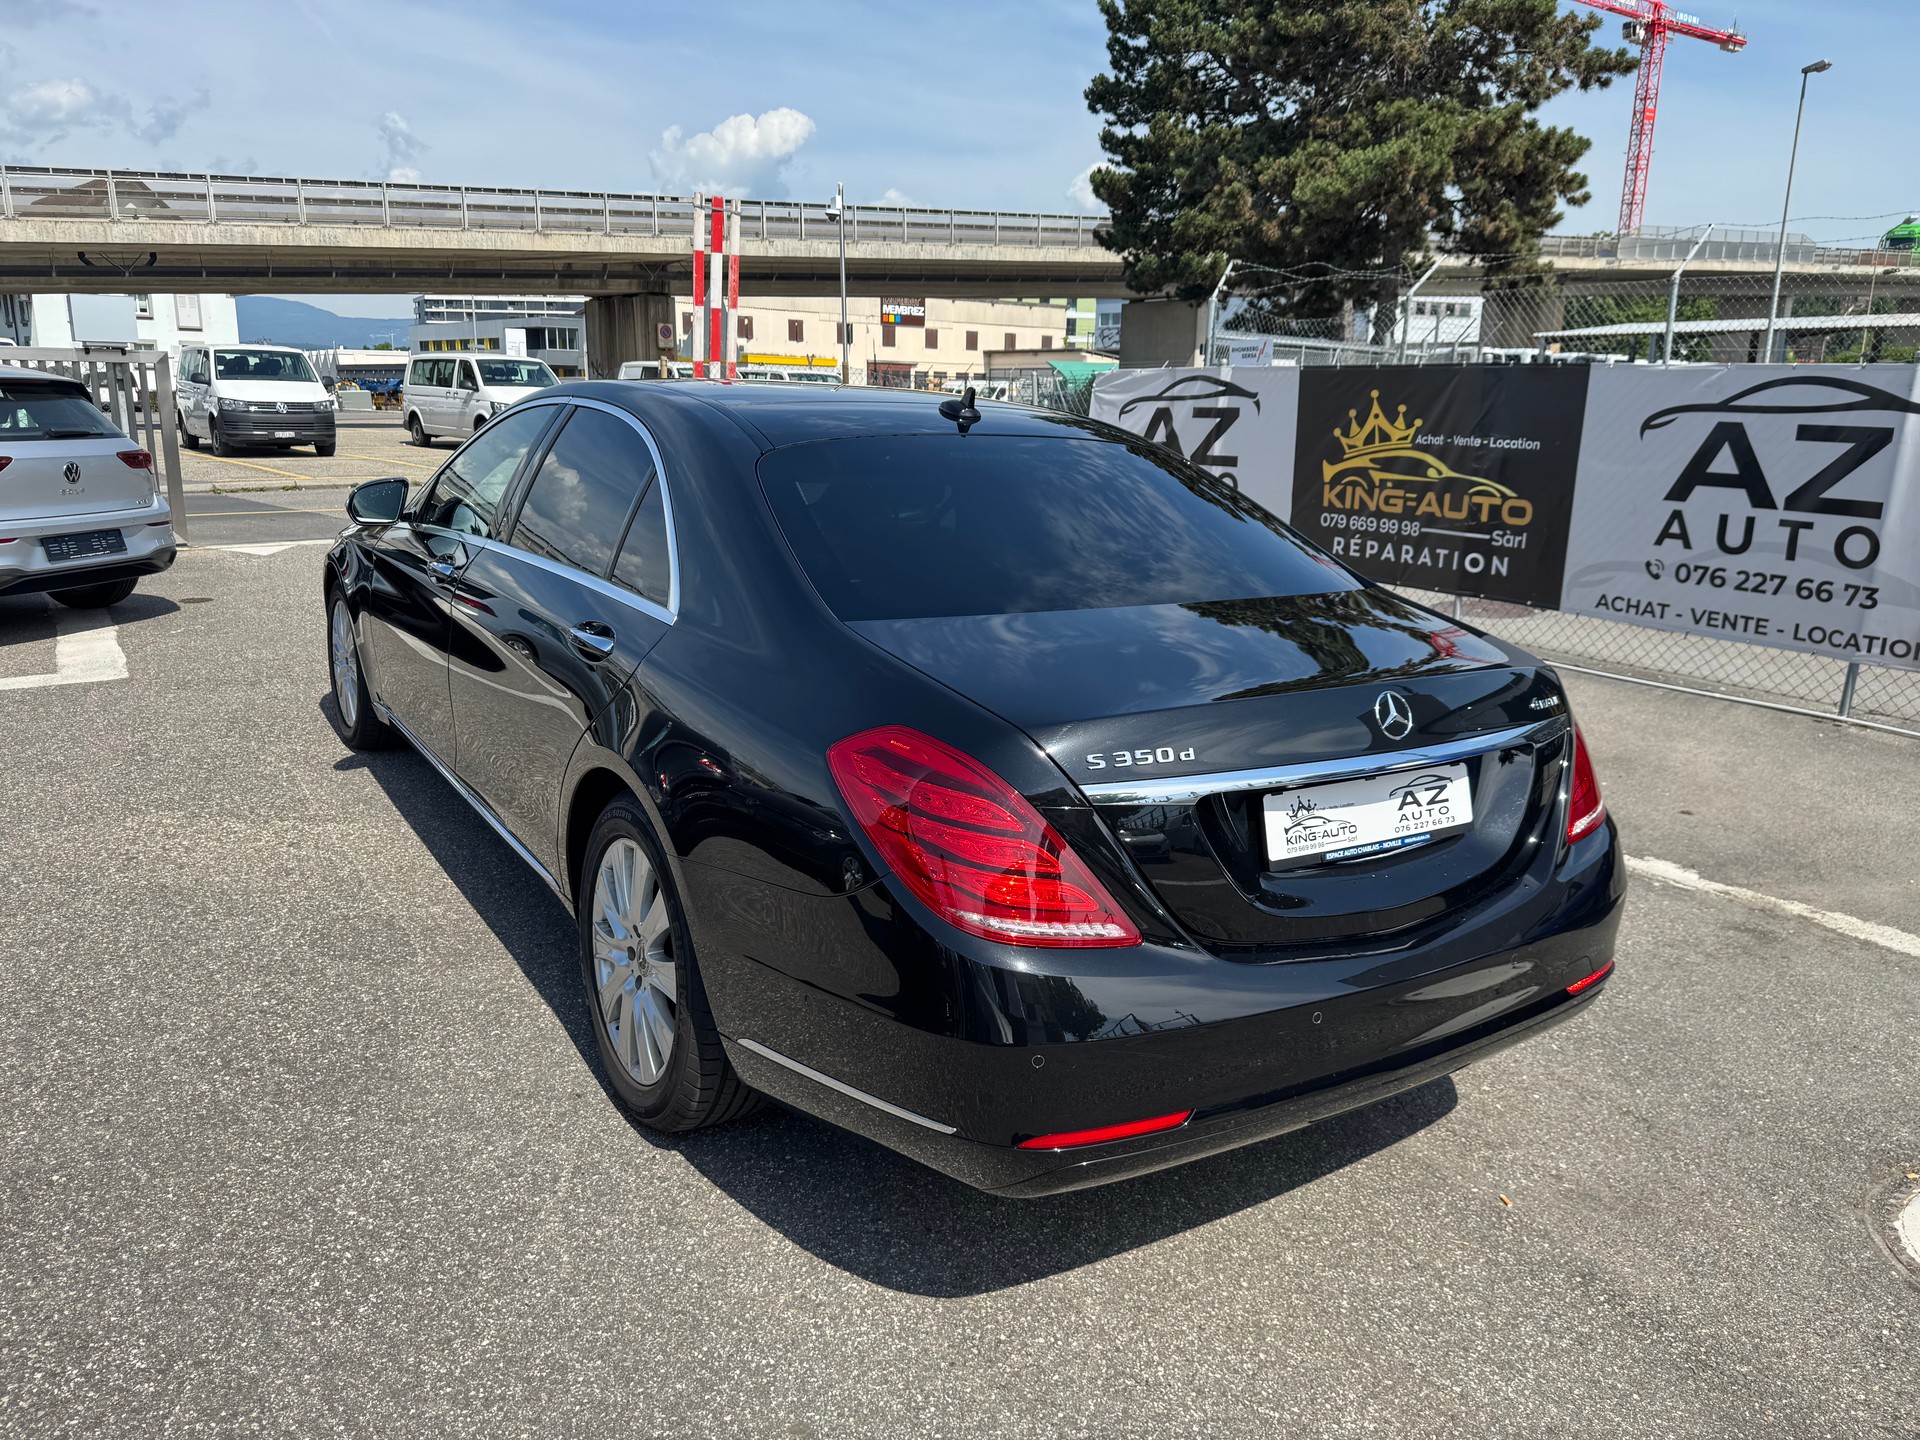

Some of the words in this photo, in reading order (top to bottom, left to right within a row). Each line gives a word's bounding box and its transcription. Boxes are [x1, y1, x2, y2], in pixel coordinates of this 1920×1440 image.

[882, 304, 925, 316] MEMBREZ
[1143, 407, 1241, 468] AZ
[1415, 434, 1445, 446] Achat
[1453, 435, 1481, 447] Vente
[1489, 436, 1541, 450] Location
[1662, 421, 1895, 520] AZ
[1320, 513, 1347, 528] 079
[1349, 514, 1377, 532] 669
[1379, 517, 1399, 534] 99
[1401, 521, 1420, 537] 98
[1491, 530, 1528, 549] Sàrl
[1653, 509, 1881, 570] AUTO
[1332, 534, 1510, 577] RÉPARATION
[1674, 563, 1727, 588] 076
[1734, 570, 1787, 596] 227
[1795, 578, 1834, 602] 66
[1843, 583, 1880, 610] 73
[1595, 593, 1670, 620] ACHAT
[1690, 607, 1770, 636] VENTE
[1086, 753, 1107, 770] S
[1112, 747, 1175, 768] 350
[1179, 747, 1196, 762] d
[1397, 784, 1450, 811] AZ
[1394, 824, 1411, 833] 076
[1413, 821, 1429, 830] 227
[1432, 818, 1443, 826] 66
[1445, 815, 1456, 823] 73
[1399, 806, 1450, 823] AUTO
[1326, 849, 1345, 860] ESPACE
[1344, 847, 1358, 857] AUTO
[1358, 843, 1380, 854] CHABLAIS
[1382, 839, 1401, 849] NOVILLE
